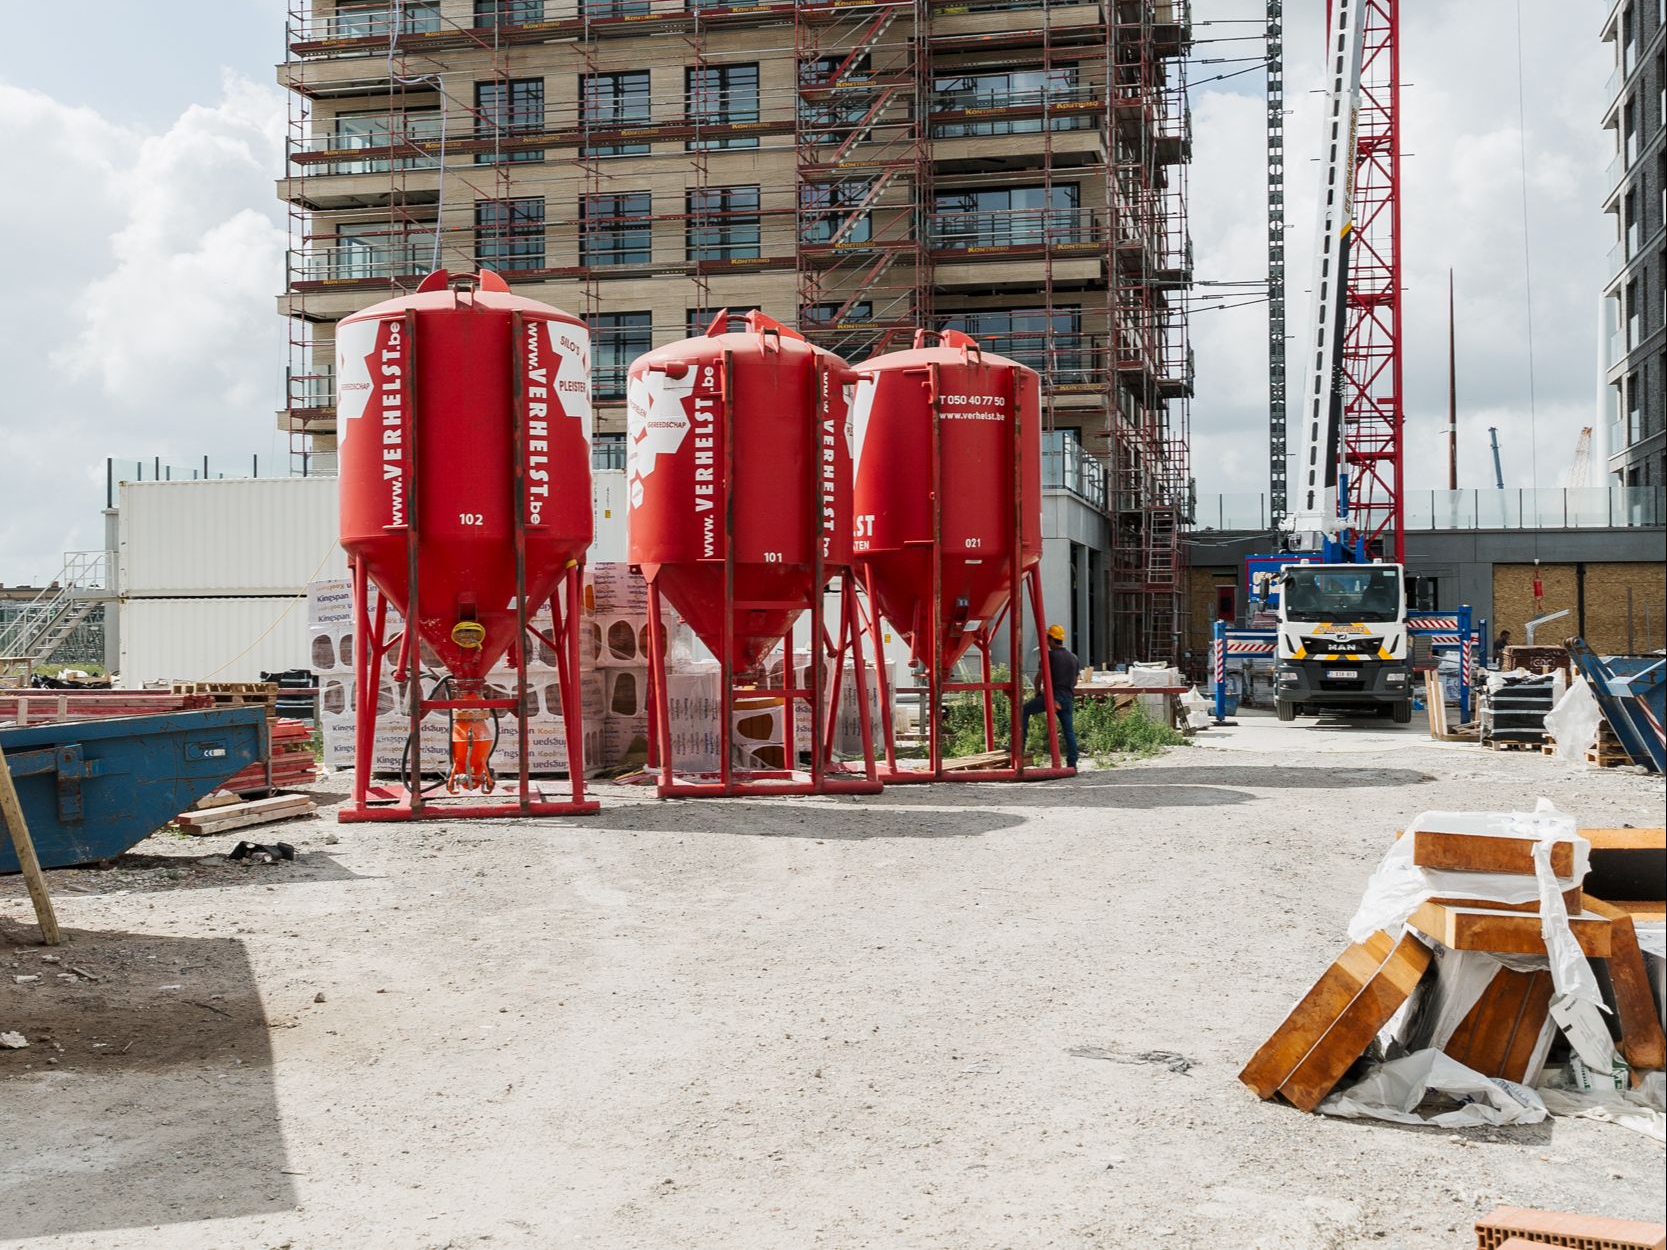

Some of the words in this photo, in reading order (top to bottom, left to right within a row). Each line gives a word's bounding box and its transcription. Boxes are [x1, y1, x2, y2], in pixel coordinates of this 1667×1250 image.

[559, 380, 587, 393] PLEISTER
[939, 395, 946, 405] T
[947, 395, 967, 405] 050
[968, 396, 981, 405] 40
[982, 396, 994, 406] 77
[994, 397, 1005, 407] 50
[939, 412, 1005, 421] www.verhelst.be
[647, 421, 687, 429] GEREEDSCHAP
[458, 512, 484, 527] 102
[853, 515, 875, 537] ST
[965, 537, 982, 549] 021
[763, 551, 783, 564] 101
